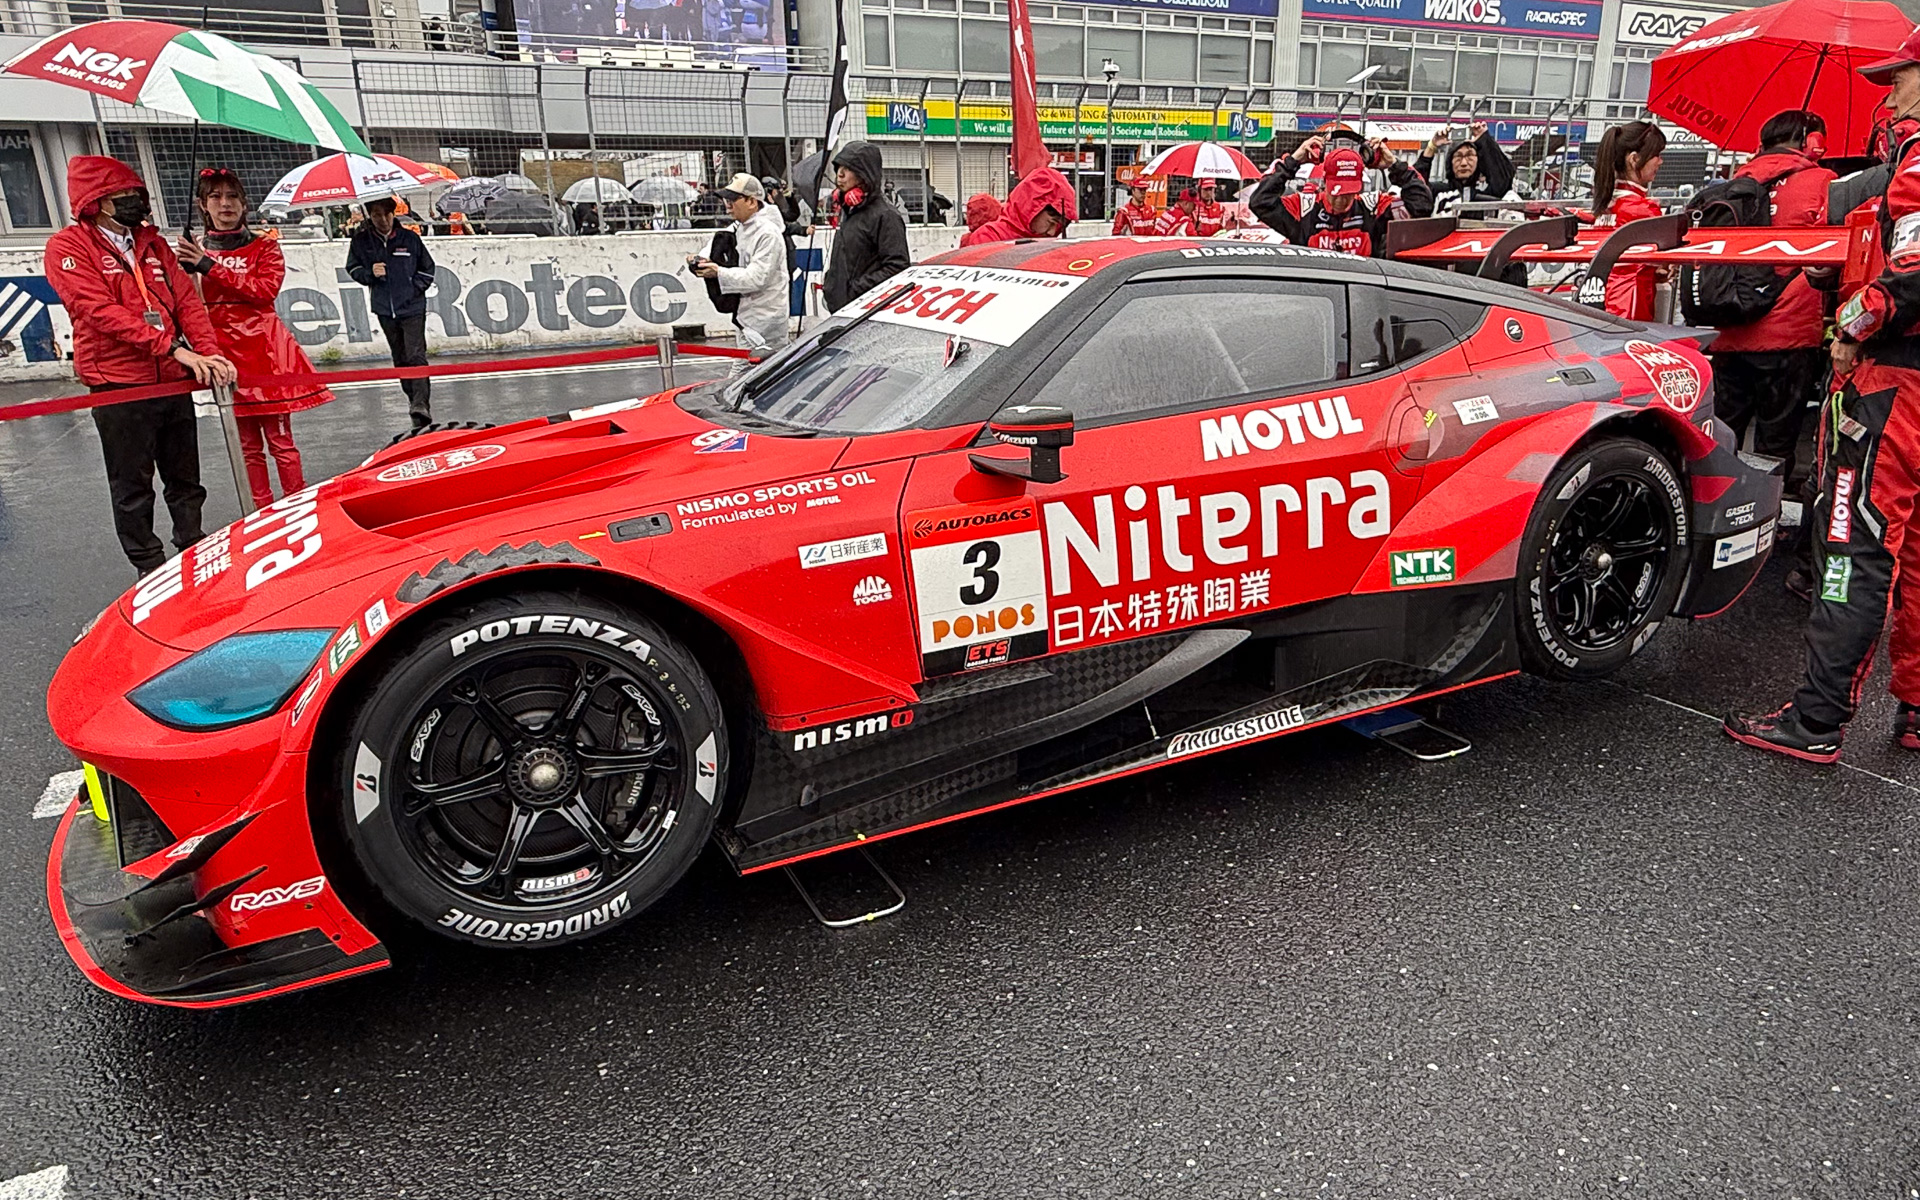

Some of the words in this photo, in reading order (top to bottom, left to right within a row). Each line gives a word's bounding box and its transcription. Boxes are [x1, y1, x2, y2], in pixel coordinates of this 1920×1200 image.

[1629, 12, 1706, 39] RAYS
[1675, 25, 1760, 52] MOTUL
[43, 62, 87, 80] SPARK
[85, 73, 127, 90] PLUGS
[52, 42, 146, 81] NGK
[974, 122, 988, 133] We
[990, 122, 1006, 133] will
[1043, 123, 1067, 134] future
[1116, 126, 1142, 138] Society
[1111, 110, 1166, 121] AUTOMATION
[303, 186, 349, 198] HONDA
[362, 170, 403, 185] HRC
[1579, 294, 1605, 303] TOOLS
[1580, 276, 1605, 295] MAC
[277, 262, 688, 346] eiRotec
[1640, 351, 1682, 368] NGK
[1661, 369, 1691, 383] SPARK
[1664, 381, 1696, 397] PLUGS
[1200, 396, 1364, 462] MOTUL
[676, 492, 750, 516] NISMO
[755, 476, 838, 503] SPORTS
[841, 471, 876, 488] OIL
[1643, 456, 1687, 546] BRIDGESTONE
[1830, 469, 1853, 540] MOTUL
[681, 502, 776, 530] Formulated
[778, 501, 798, 516] by
[806, 495, 842, 509] MOTUL
[935, 507, 1032, 532] AUTOBACS
[830, 537, 885, 559] 日新産業
[1043, 469, 1392, 597] Niterra
[959, 540, 1001, 606] 3
[1394, 549, 1452, 576] NTK
[1825, 556, 1844, 598] NTK
[853, 575, 892, 599] MAC
[853, 591, 893, 606] TOOLS
[932, 603, 1035, 643] PONOS
[1053, 567, 1271, 648] 日本特殊陶業
[1530, 575, 1580, 669] POTENZA
[450, 614, 651, 662] POTENZA
[968, 641, 1009, 661] ETS
[621, 683, 661, 727] RAYS
[410, 708, 442, 763] RAYS
[793, 710, 914, 752] nismo
[1168, 705, 1303, 757] BRIDGESTONE
[626, 772, 645, 805] ACING
[230, 875, 327, 912] RAYS
[521, 866, 591, 891] nismo
[438, 891, 632, 943] BRIDGESTONE
